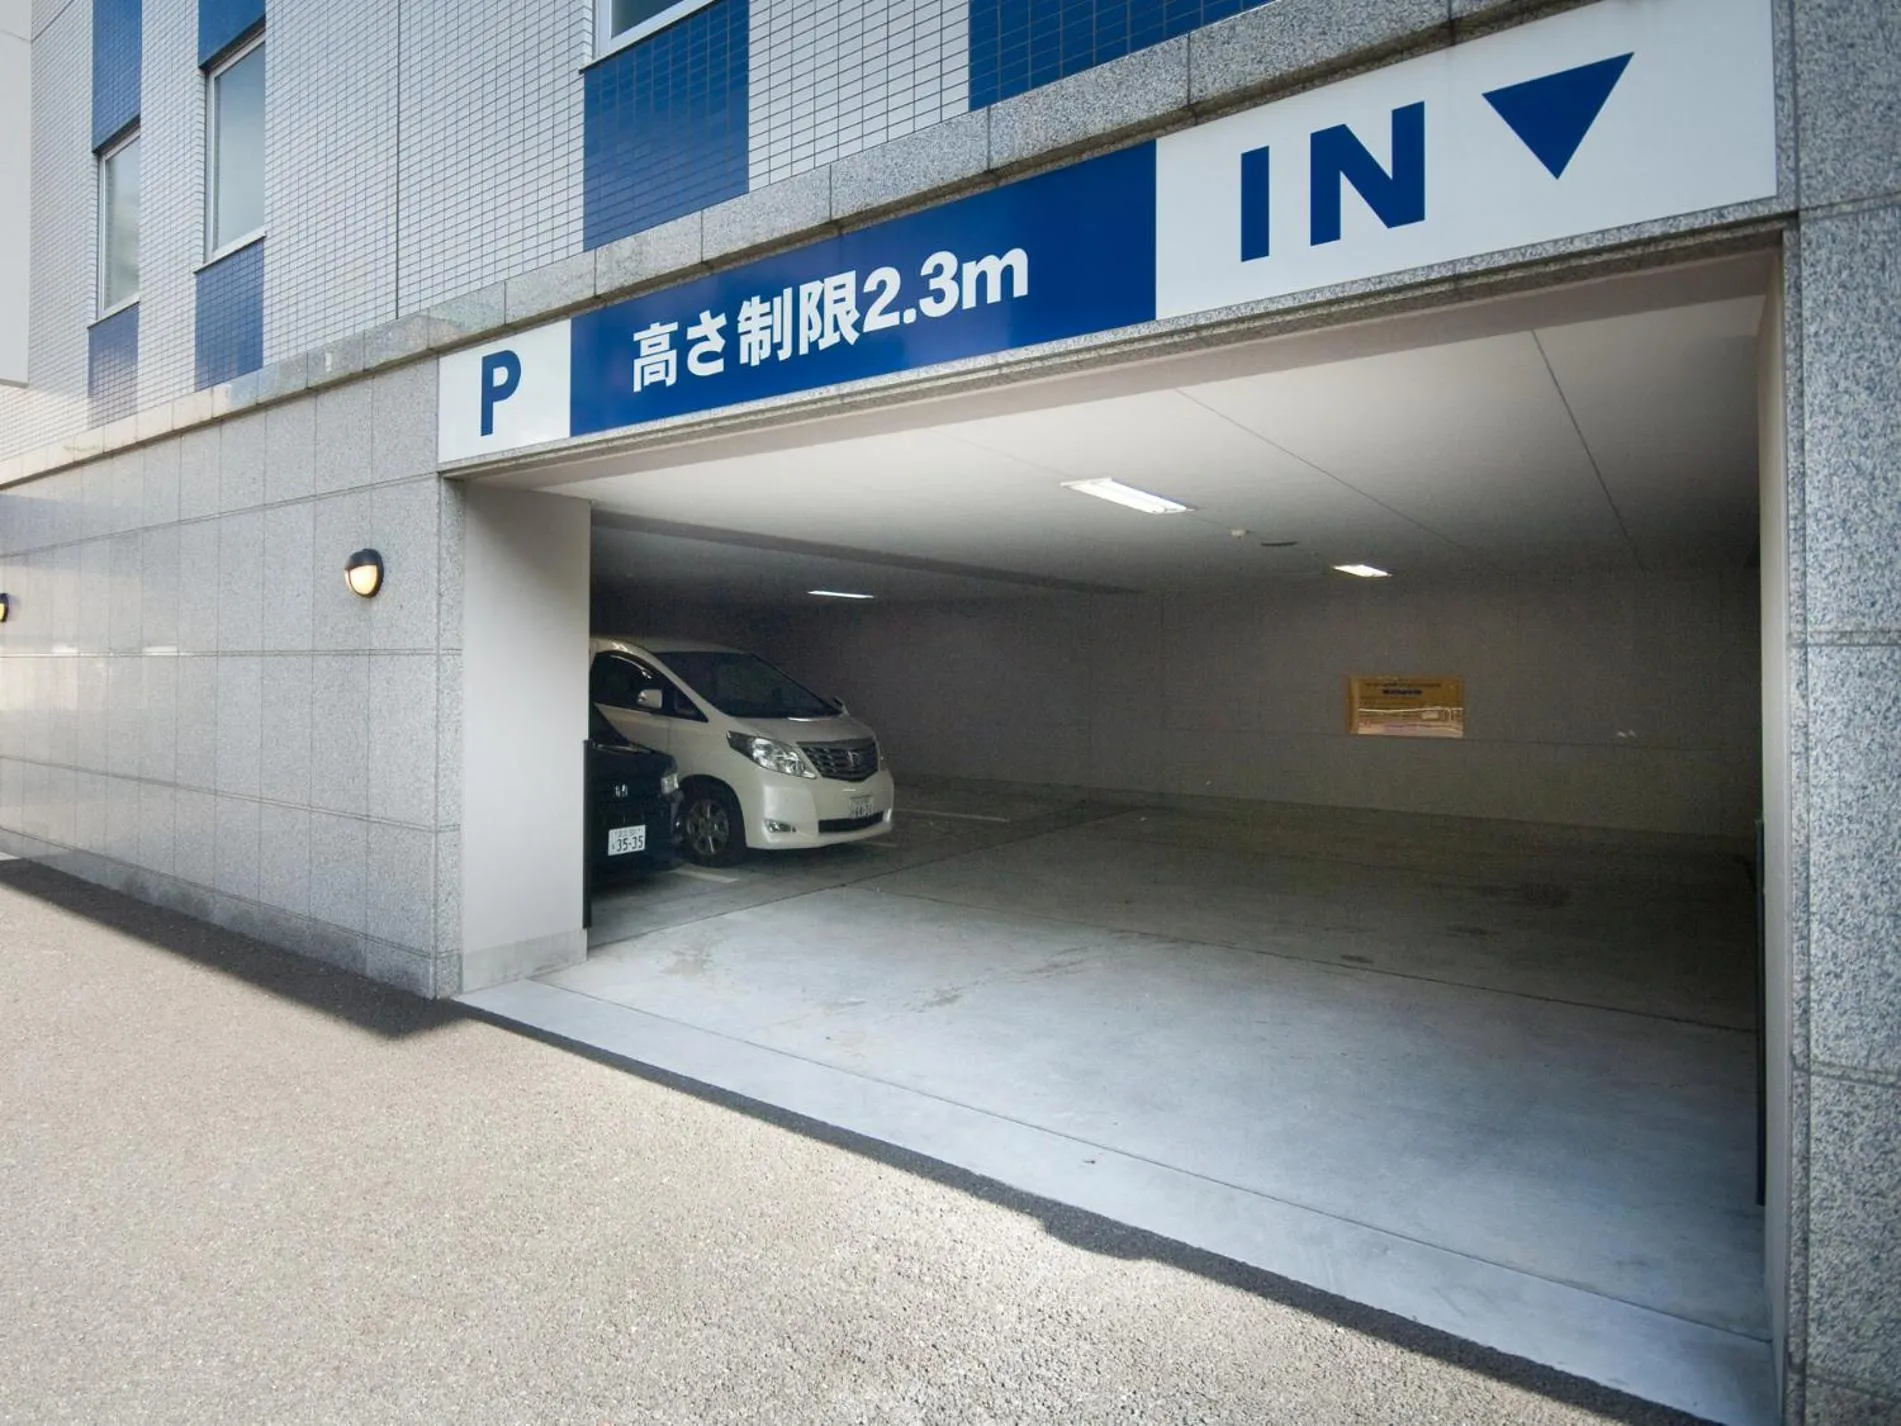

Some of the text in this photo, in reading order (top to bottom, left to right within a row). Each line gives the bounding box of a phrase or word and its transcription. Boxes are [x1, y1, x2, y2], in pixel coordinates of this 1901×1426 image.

[1241, 100, 1425, 262] IN
[632, 248, 1029, 393] 高さ制限2.3m
[480, 350, 521, 437] P
